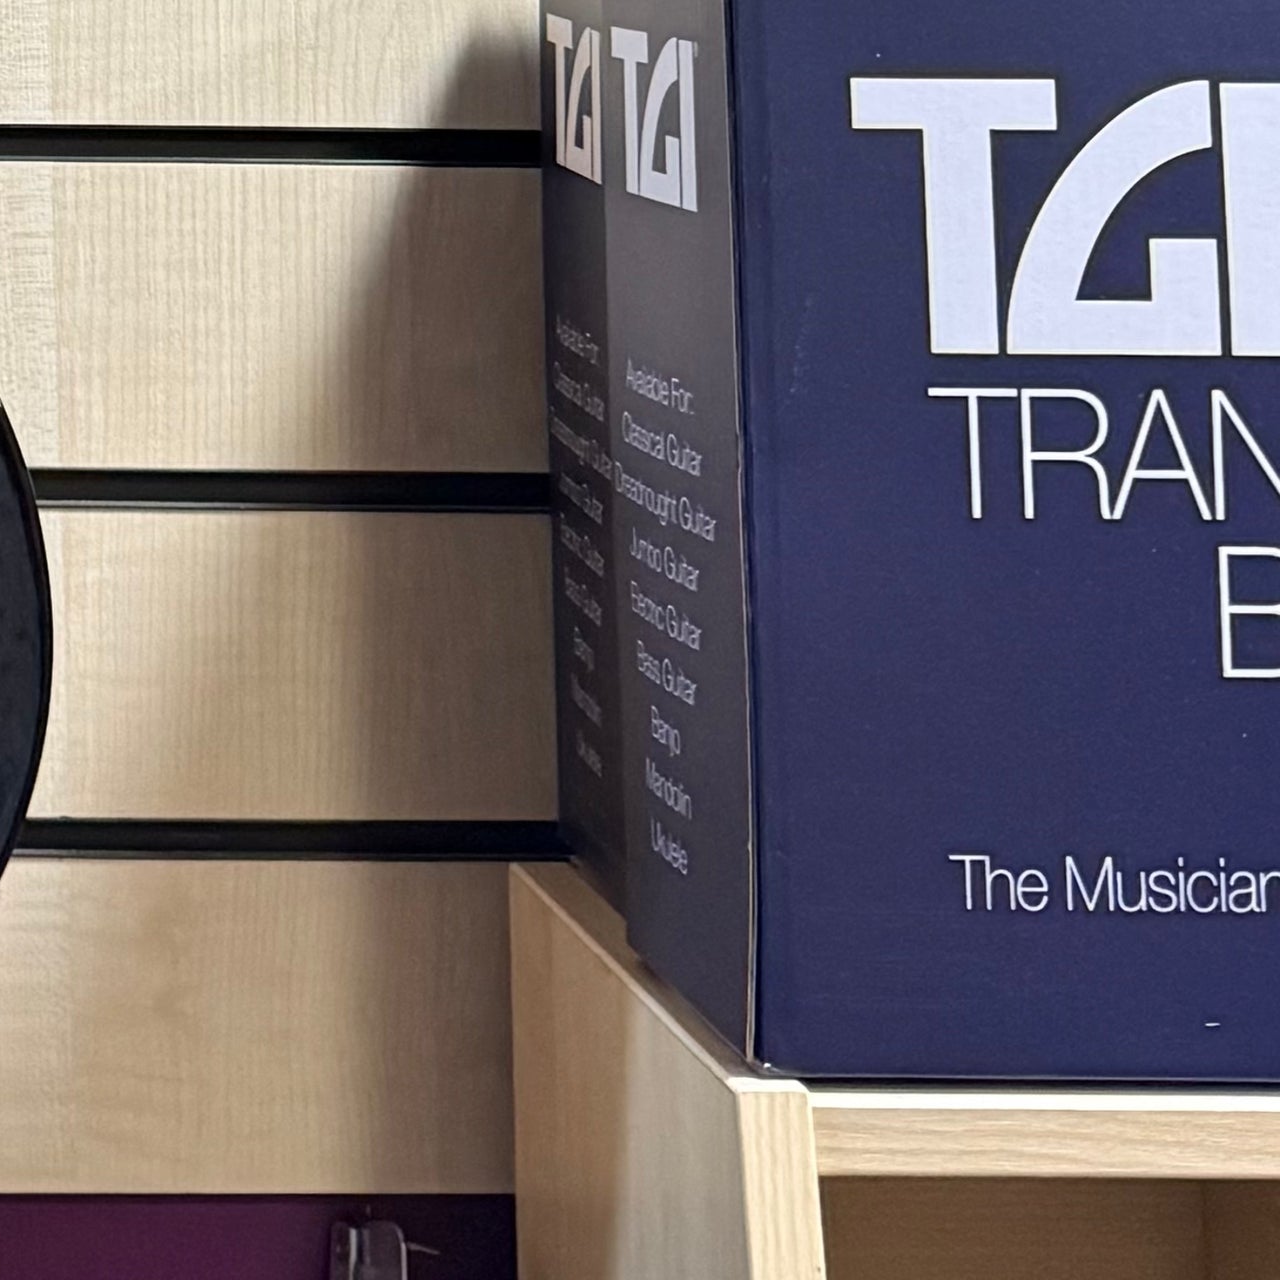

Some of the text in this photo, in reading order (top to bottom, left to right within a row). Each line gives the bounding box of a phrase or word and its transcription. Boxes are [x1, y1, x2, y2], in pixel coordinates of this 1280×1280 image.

[547, 13, 602, 184] TGI
[611, 27, 697, 212] TGI
[850, 78, 1280, 356] TGI
[666, 433, 704, 477] Guitar
[679, 496, 717, 541] Guitar
[663, 546, 700, 592] Guitar
[665, 605, 702, 651] Guitar
[637, 640, 661, 685] Bass
[661, 658, 697, 706] Guitar
[651, 705, 681, 757] Banjo
[949, 855, 1280, 913] The Musician
